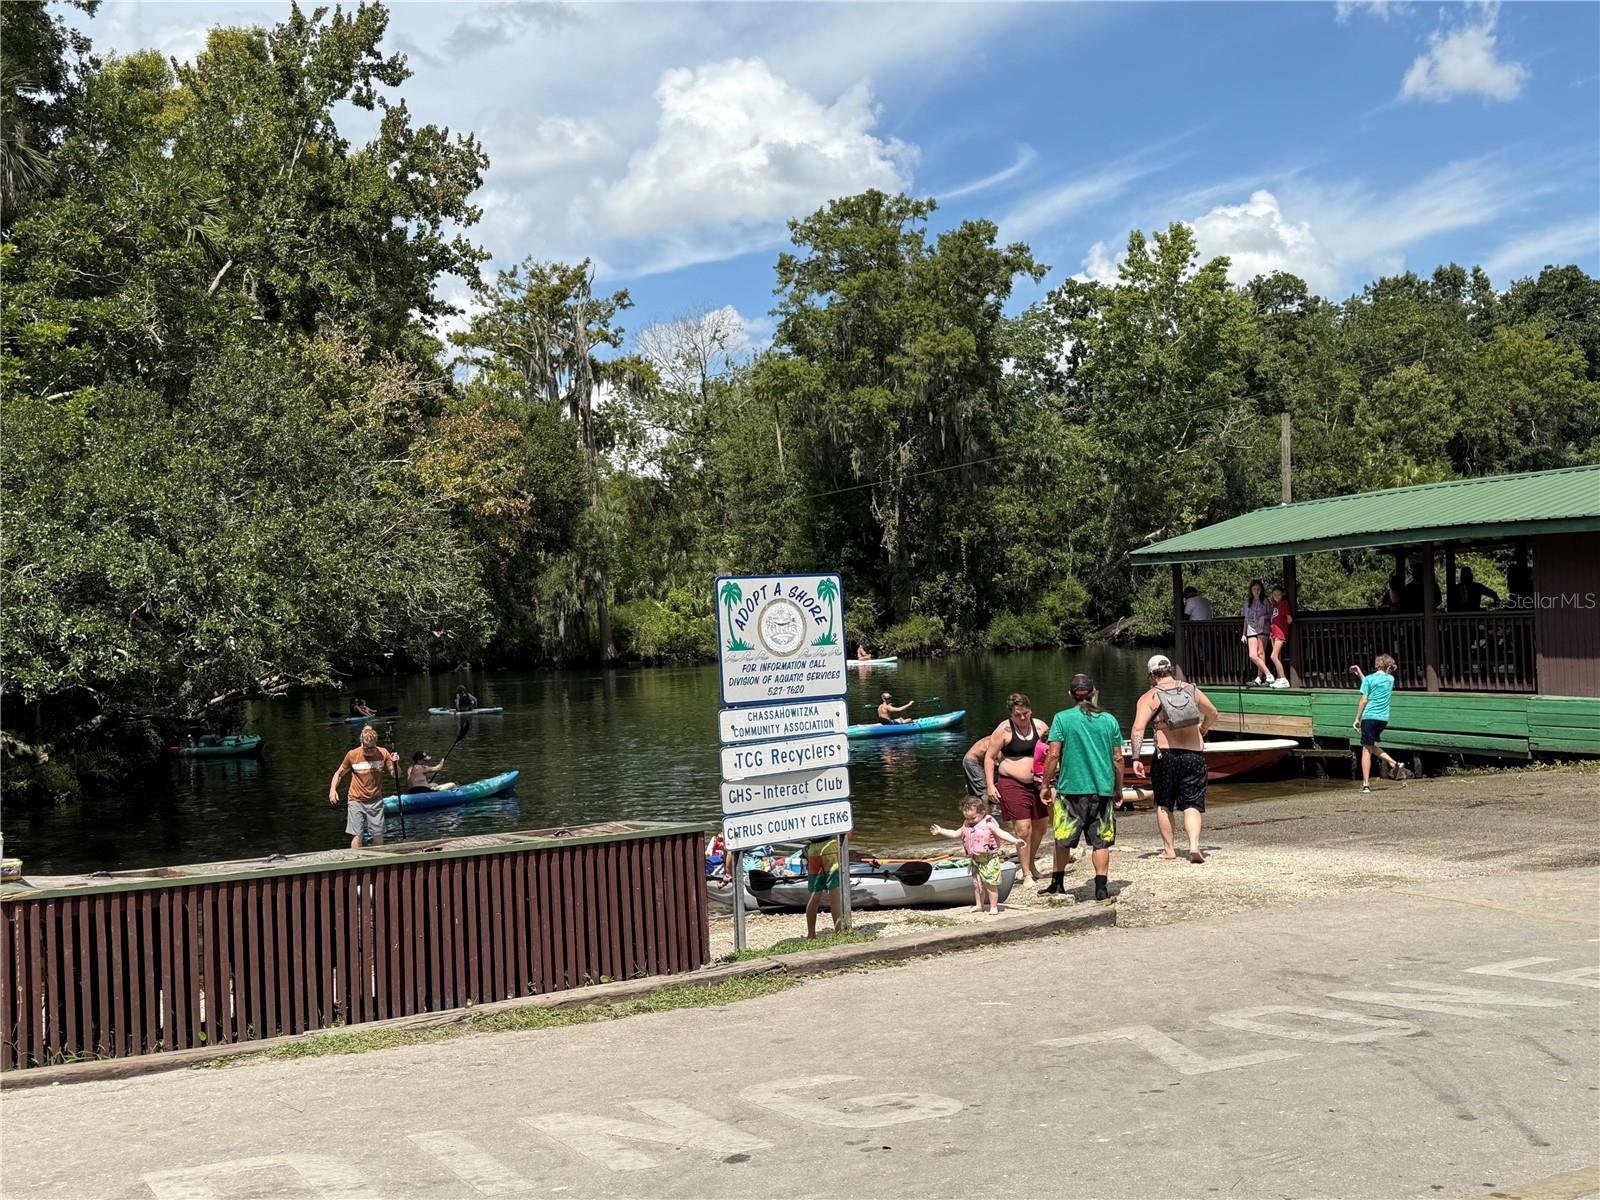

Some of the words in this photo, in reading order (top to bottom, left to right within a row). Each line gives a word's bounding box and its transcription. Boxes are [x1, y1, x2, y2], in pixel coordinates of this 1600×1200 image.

[735, 584, 768, 632] ADOPT
[773, 582, 782, 597] A
[788, 585, 828, 626] SHORE
[742, 663, 757, 673] FOR
[759, 660, 806, 672] INFORMATION
[808, 659, 827, 669] CALL
[728, 676, 760, 687] DIVISION
[762, 675, 772, 685] OF
[774, 674, 804, 683] AQUATIC
[806, 670, 841, 681] SERVICES
[747, 706, 820, 722] CHASSAHOWITZKA
[733, 724, 780, 738] COMMUNITY
[783, 718, 835, 734] ASSOCIATION
[735, 750, 763, 769] TCG
[771, 744, 835, 766] Recyclers
[816, 777, 842, 792] Club
[727, 823, 763, 840] CITRUS
[811, 810, 849, 827] CLERKS
